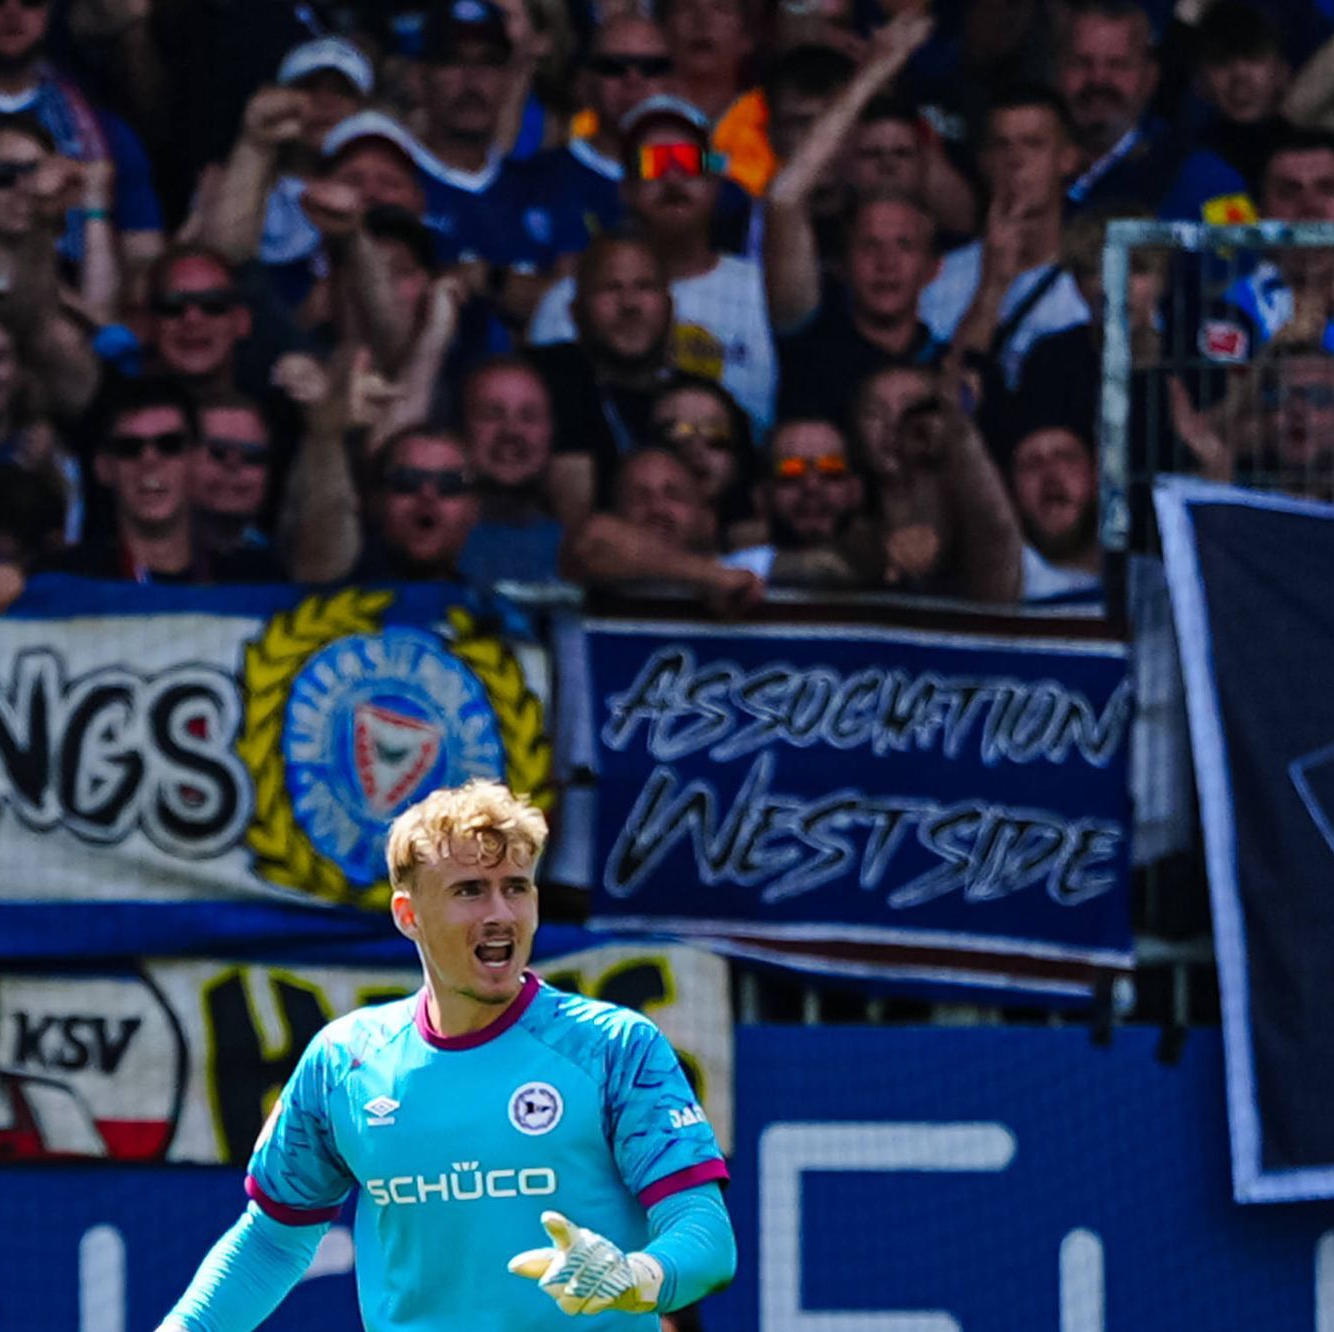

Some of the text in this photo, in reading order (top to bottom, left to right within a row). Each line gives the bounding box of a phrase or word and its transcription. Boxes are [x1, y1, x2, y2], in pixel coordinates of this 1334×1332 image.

[600, 645, 1133, 770] ASSOCIATION
[12, 1002, 141, 1074] KSV
[367, 1161, 557, 1207] SCHÜCO
